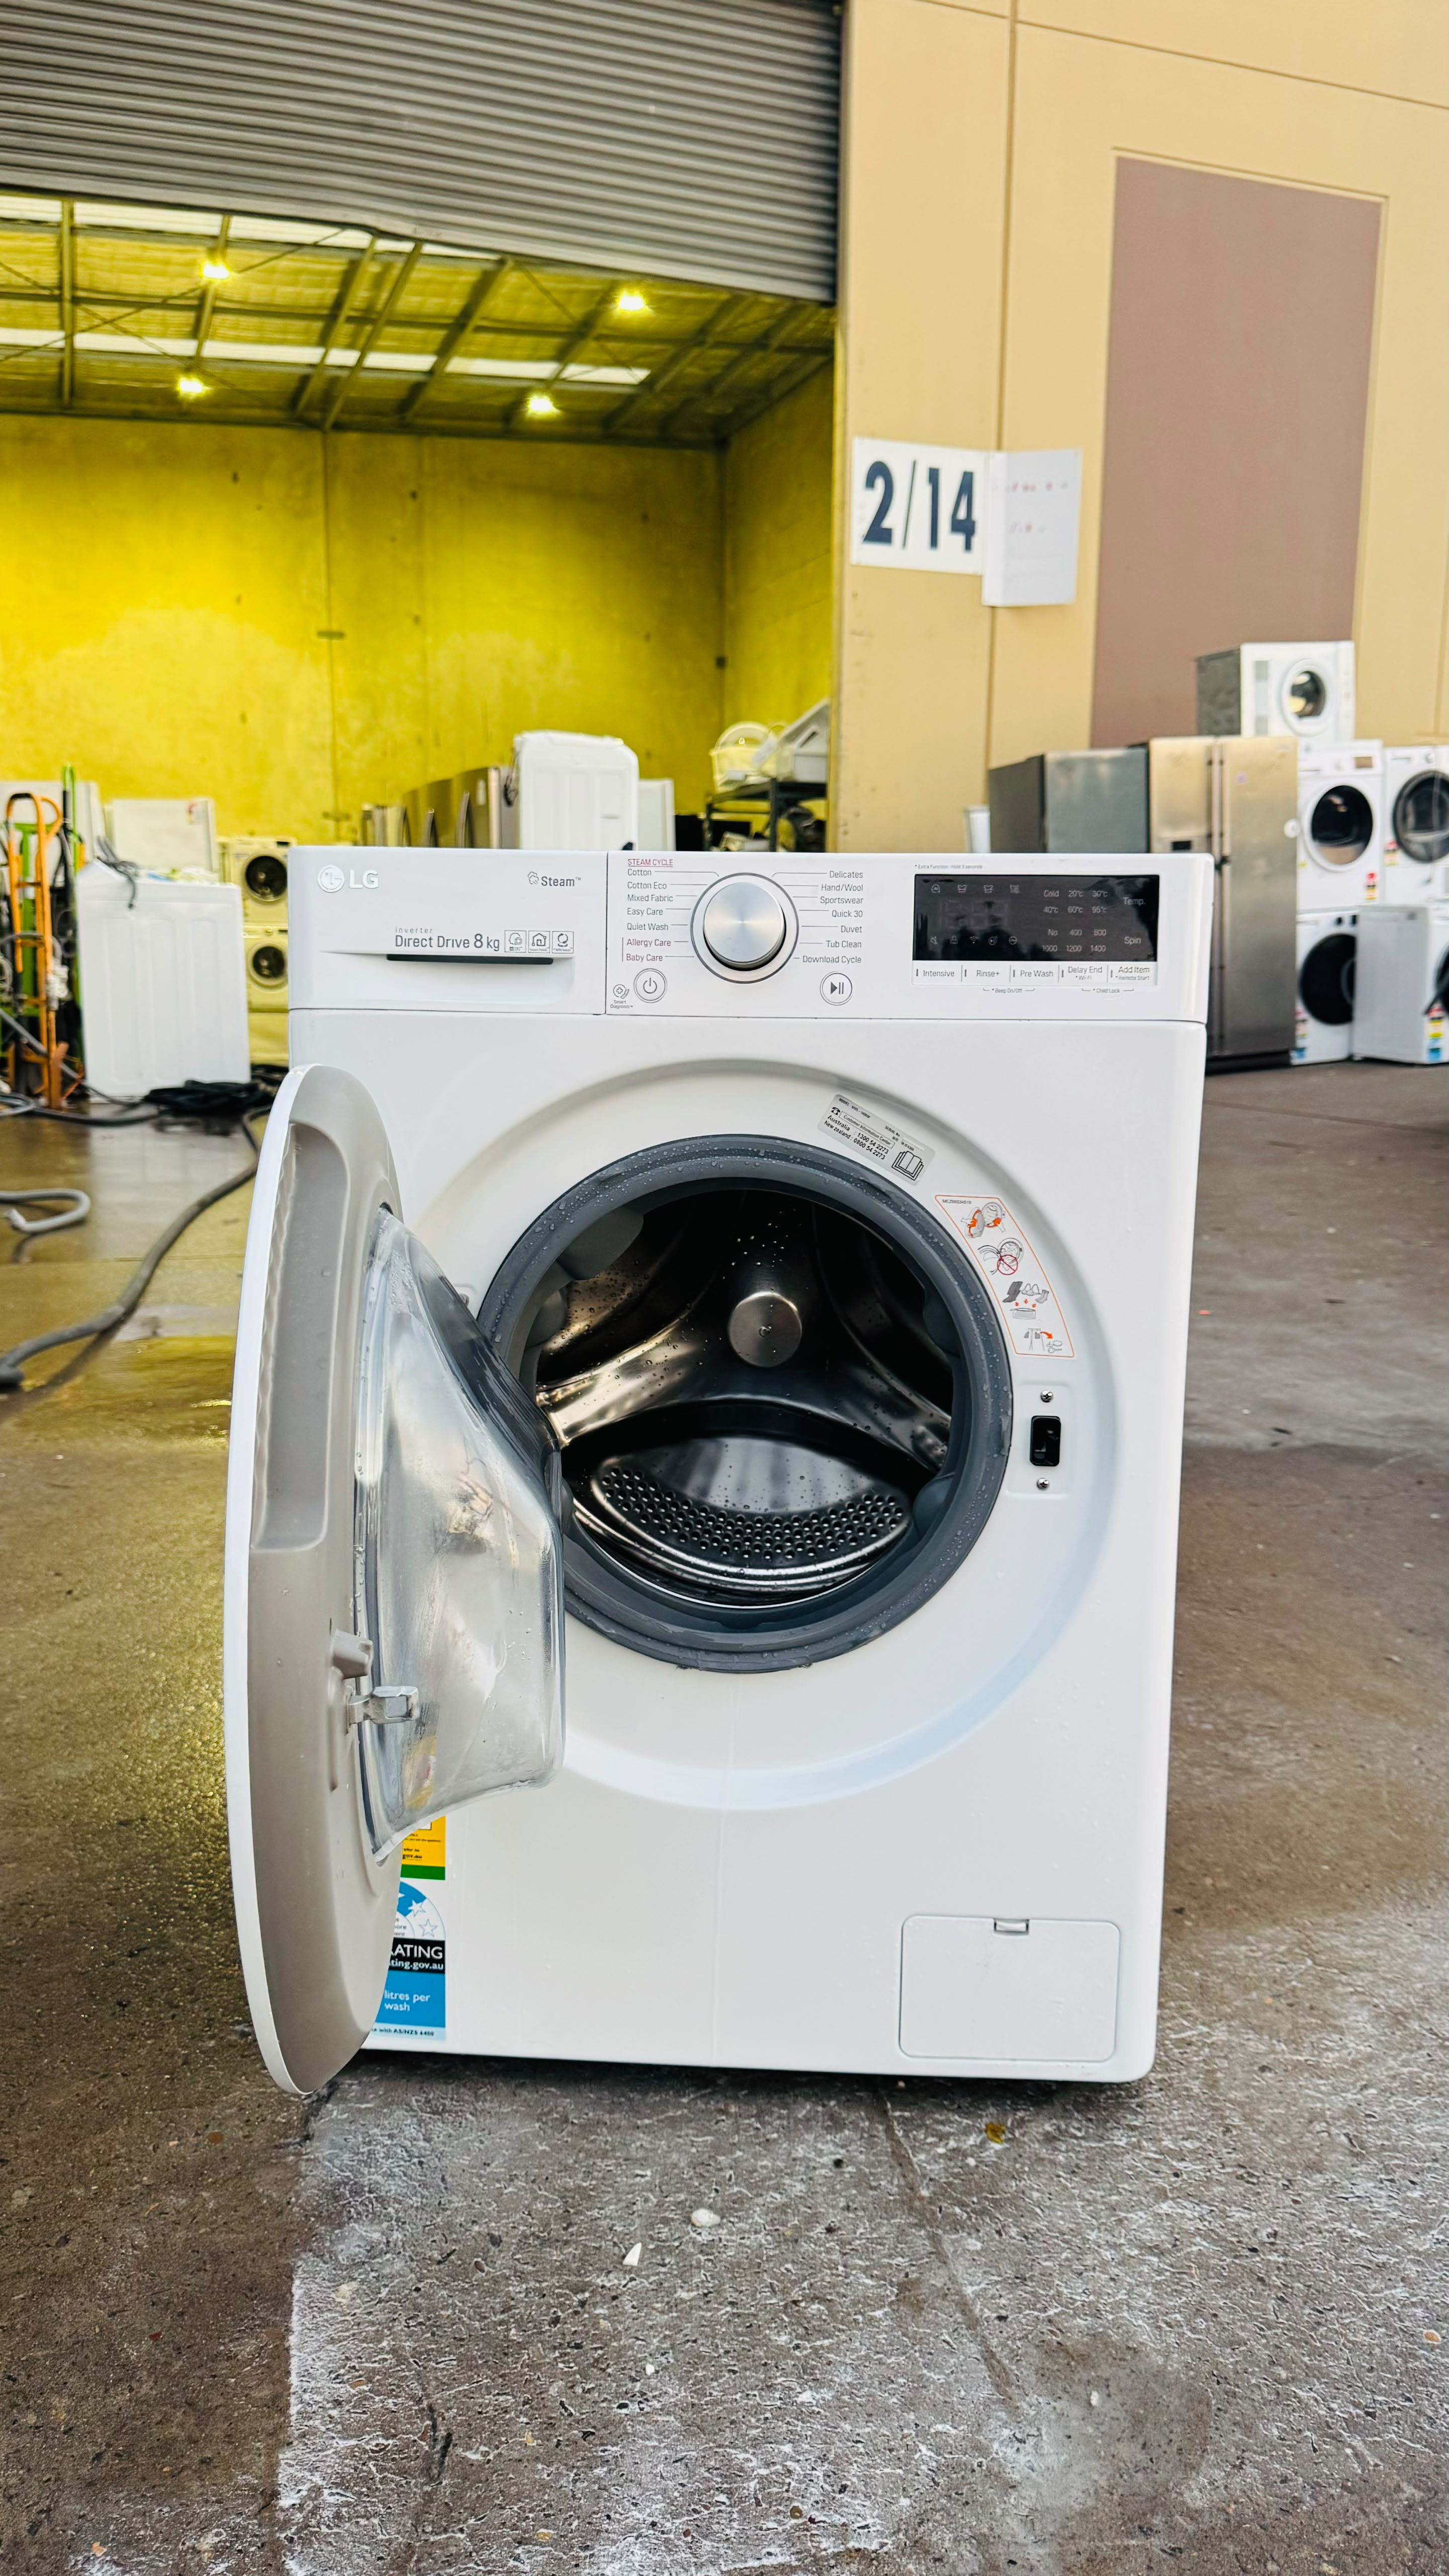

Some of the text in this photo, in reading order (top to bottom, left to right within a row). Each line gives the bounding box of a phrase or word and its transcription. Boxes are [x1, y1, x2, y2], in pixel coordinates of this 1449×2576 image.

[862, 460, 976, 553] 2/14
[627, 868, 652, 876] Cotton
[350, 869, 379, 889] LG
[820, 896, 864, 905] Sportswear
[1122, 897, 1146, 906] Temp.
[627, 908, 644, 916] Easy
[832, 910, 852, 918] Quick
[627, 922, 646, 930] Quiet
[395, 933, 500, 951] Direct Drive 8 kg
[626, 938, 653, 947] Allergy
[1124, 936, 1141, 945] Spin
[626, 953, 644, 962] Baby
[841, 955, 861, 964] Cycle
[1068, 966, 1087, 974] Delay
[827, 1115, 850, 1132] Australia
[857, 1133, 869, 1143] 1300
[876, 1144, 889, 1154] 2273
[824, 1120, 834, 1129] New
[853, 1138, 866, 1148] 0800
[872, 1150, 886, 1160] 2273
[389, 1959, 443, 1970] ting.gov.au
[384, 1989, 430, 2003] litres per
[384, 2002, 410, 2011] wash
